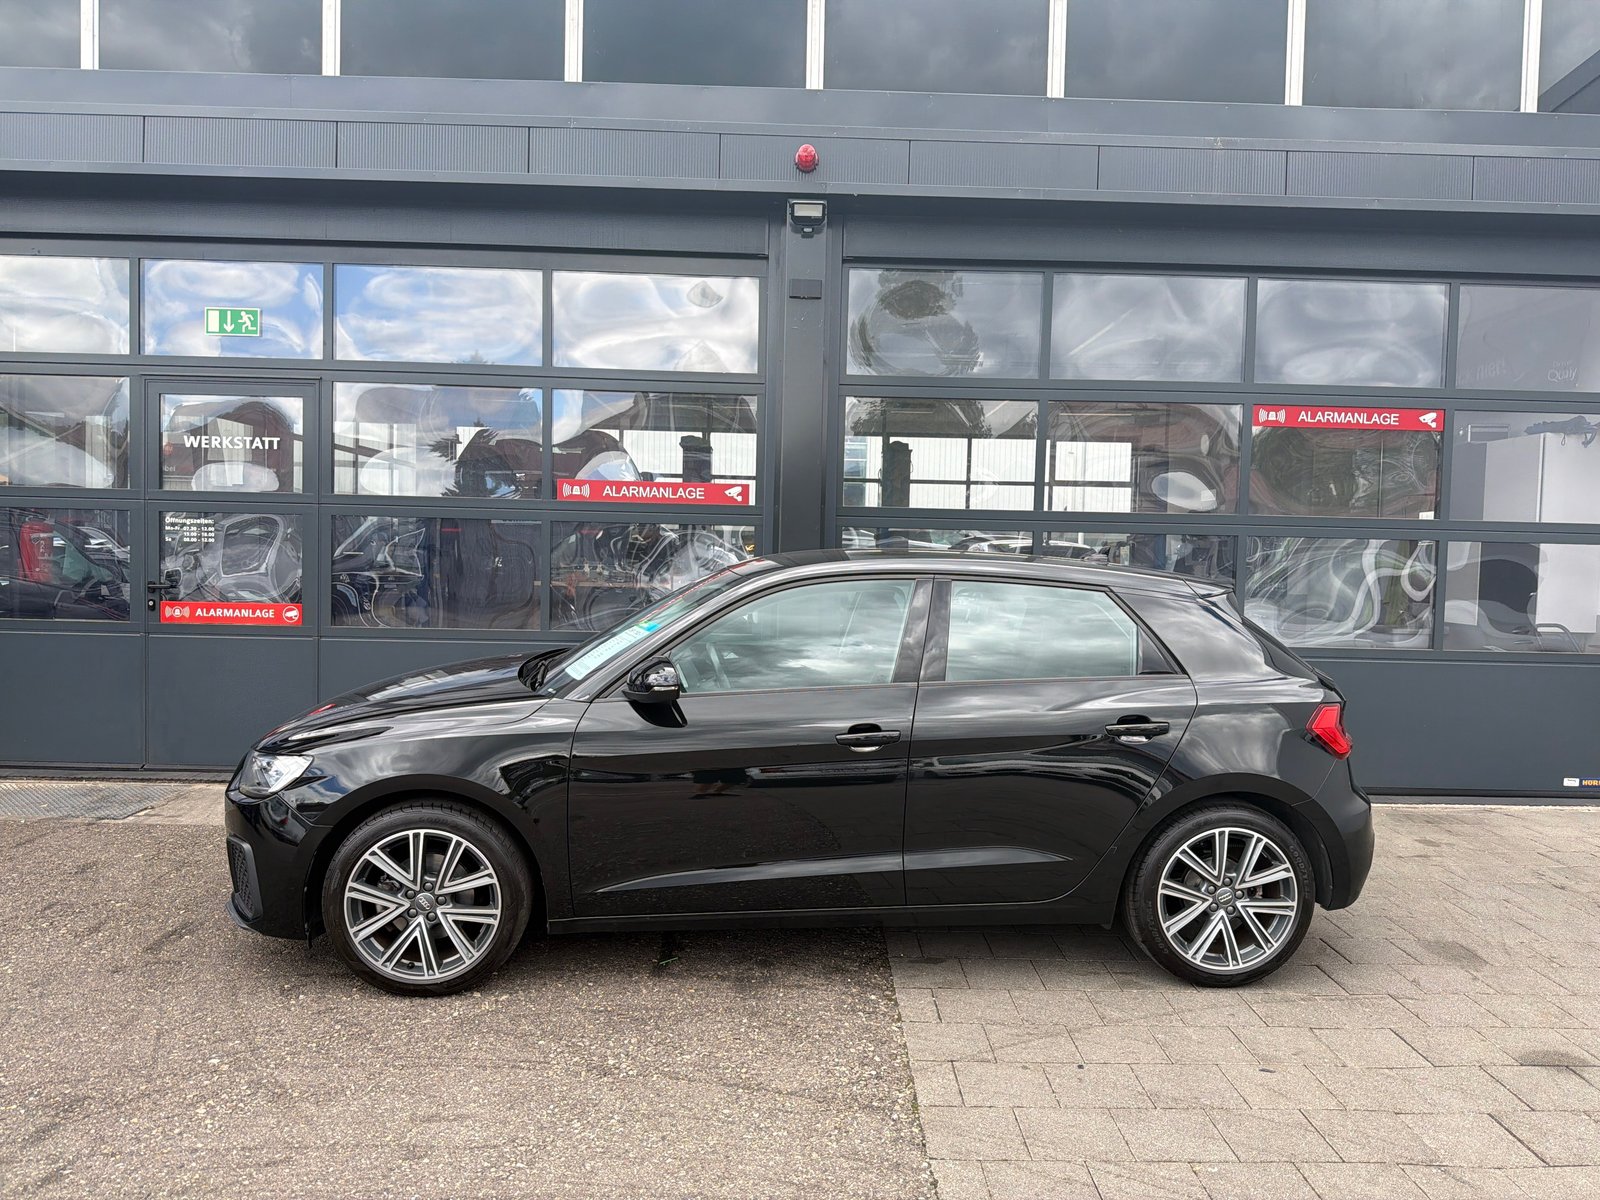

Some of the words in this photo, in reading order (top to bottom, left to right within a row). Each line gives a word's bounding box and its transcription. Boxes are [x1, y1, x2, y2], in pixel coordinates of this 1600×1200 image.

[1298, 411, 1399, 425] ALARMANLAGE
[183, 435, 280, 450] WERKSTATT
[602, 485, 705, 499] ALARMANLAGE
[195, 607, 275, 618] ALARMANLAGE
